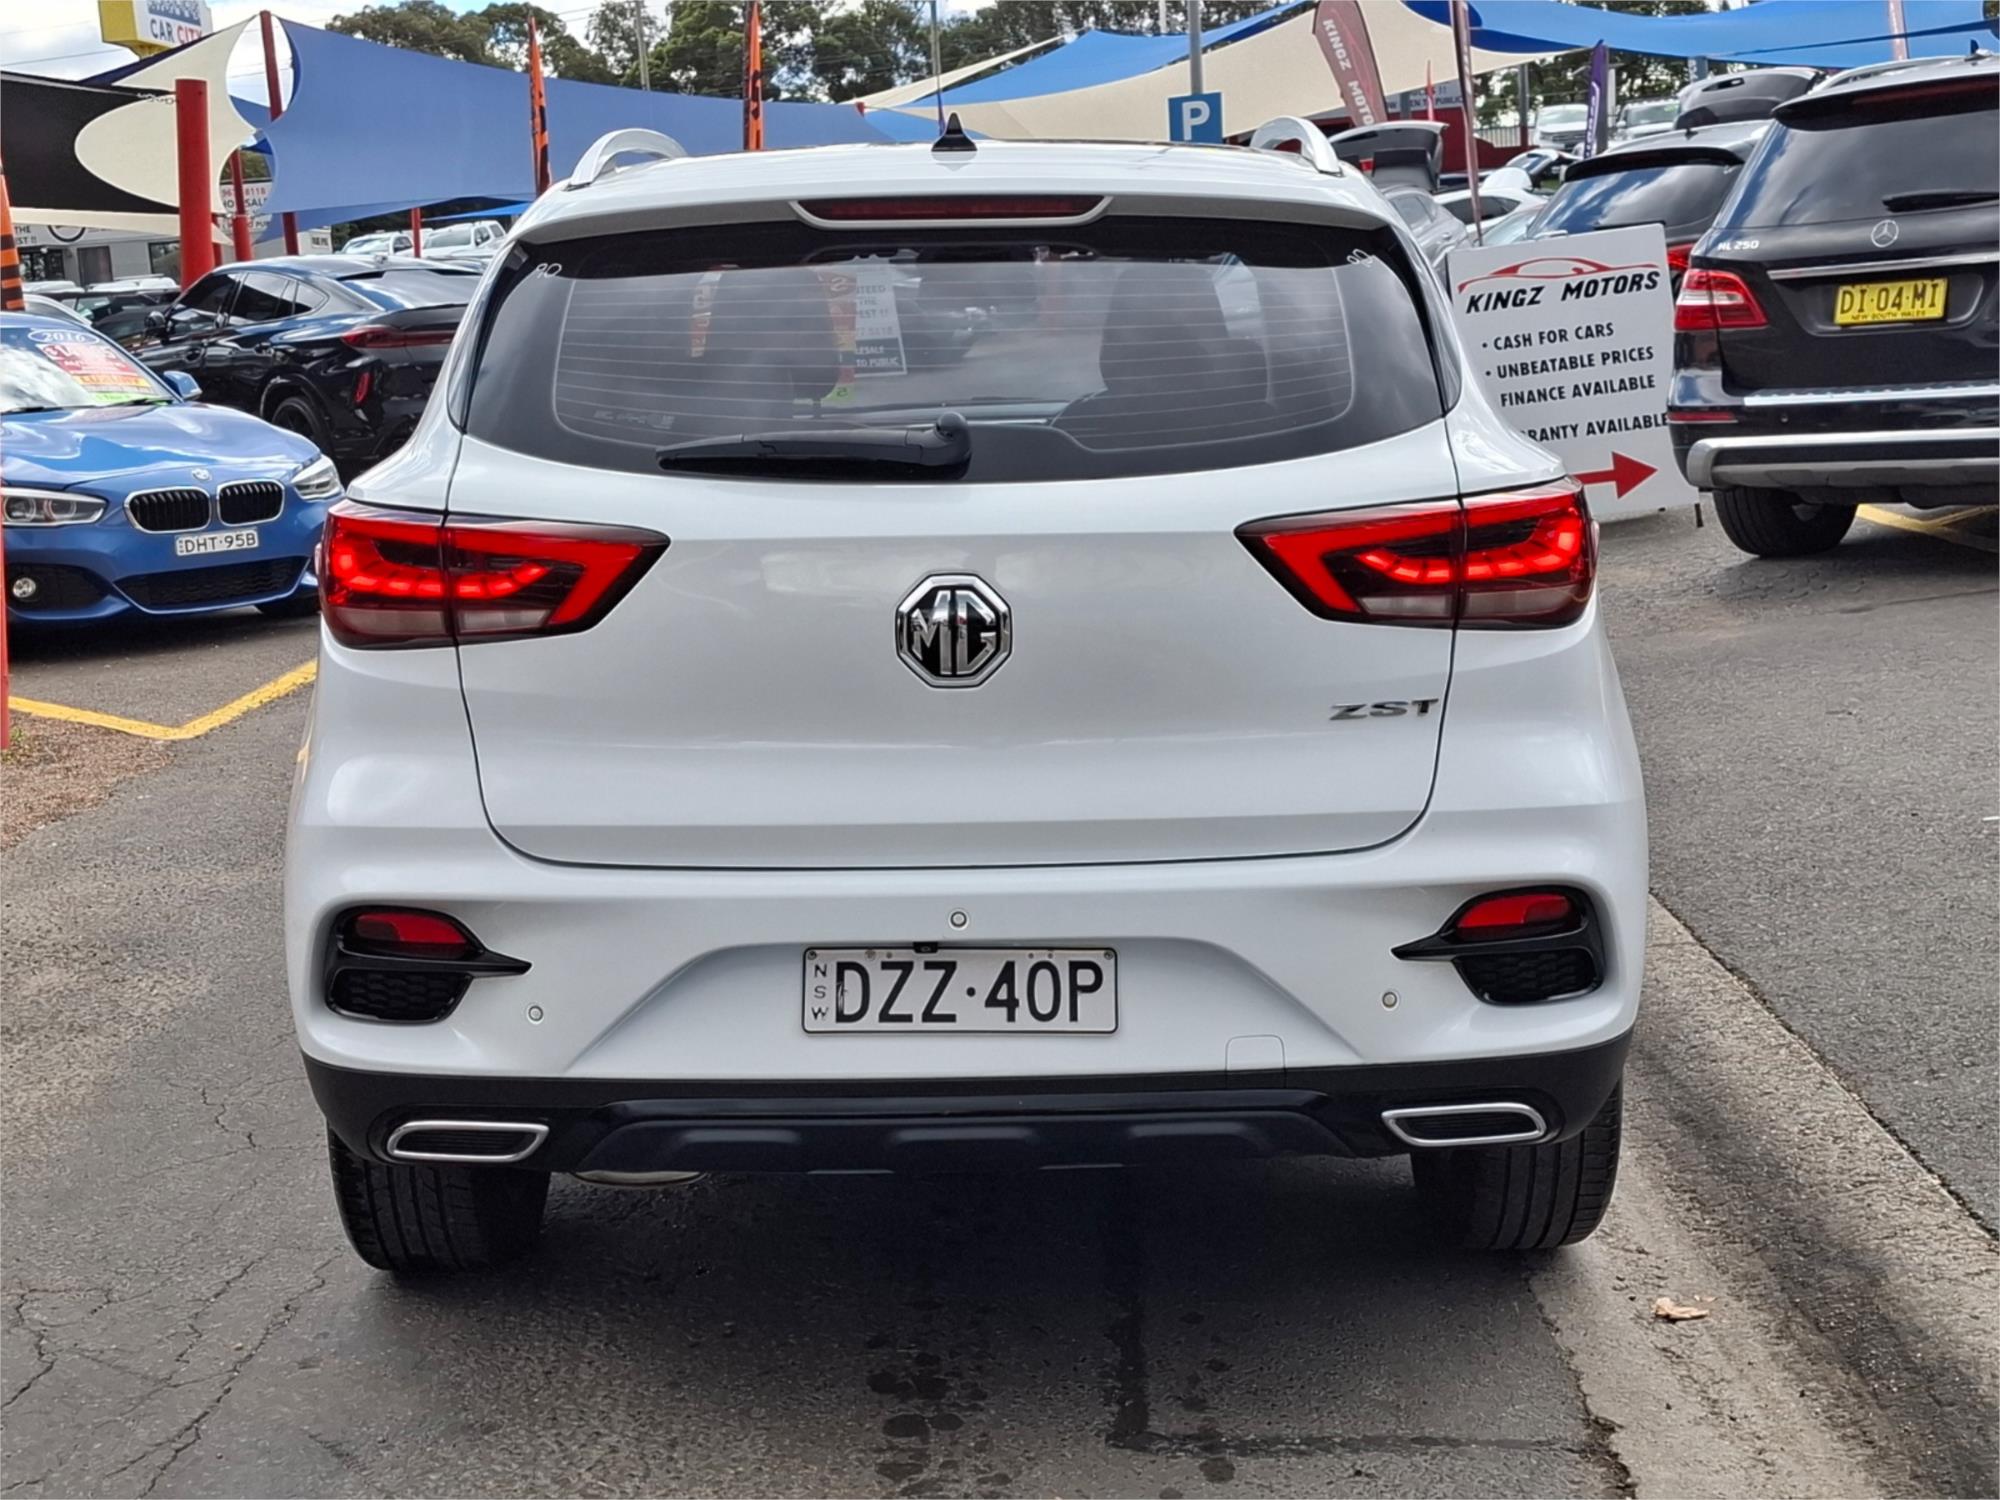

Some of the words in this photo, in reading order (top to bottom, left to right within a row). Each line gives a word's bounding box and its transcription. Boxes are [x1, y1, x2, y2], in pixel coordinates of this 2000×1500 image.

[150, 18, 175, 43] CAR
[1323, 19, 1352, 71] KINGZ
[1348, 80, 1375, 127] MOTO
[1182, 101, 1210, 141] P
[1466, 286, 1545, 314] KINGZ
[1561, 271, 1660, 301] MOTORS
[1493, 333, 1533, 351] CASH
[1538, 328, 1569, 345] FOR
[1574, 322, 1615, 341] CARS
[1497, 353, 1596, 379] UNBEATABLE
[1601, 346, 1654, 366] PRICES
[1501, 385, 1566, 407] FINANCE
[1571, 375, 1656, 399] AVAILABLE
[1521, 423, 1580, 442] RANTY
[1586, 413, 1669, 436] AVAILABLE
[911, 590, 996, 675] MG
[1329, 698, 1440, 721] ZST
